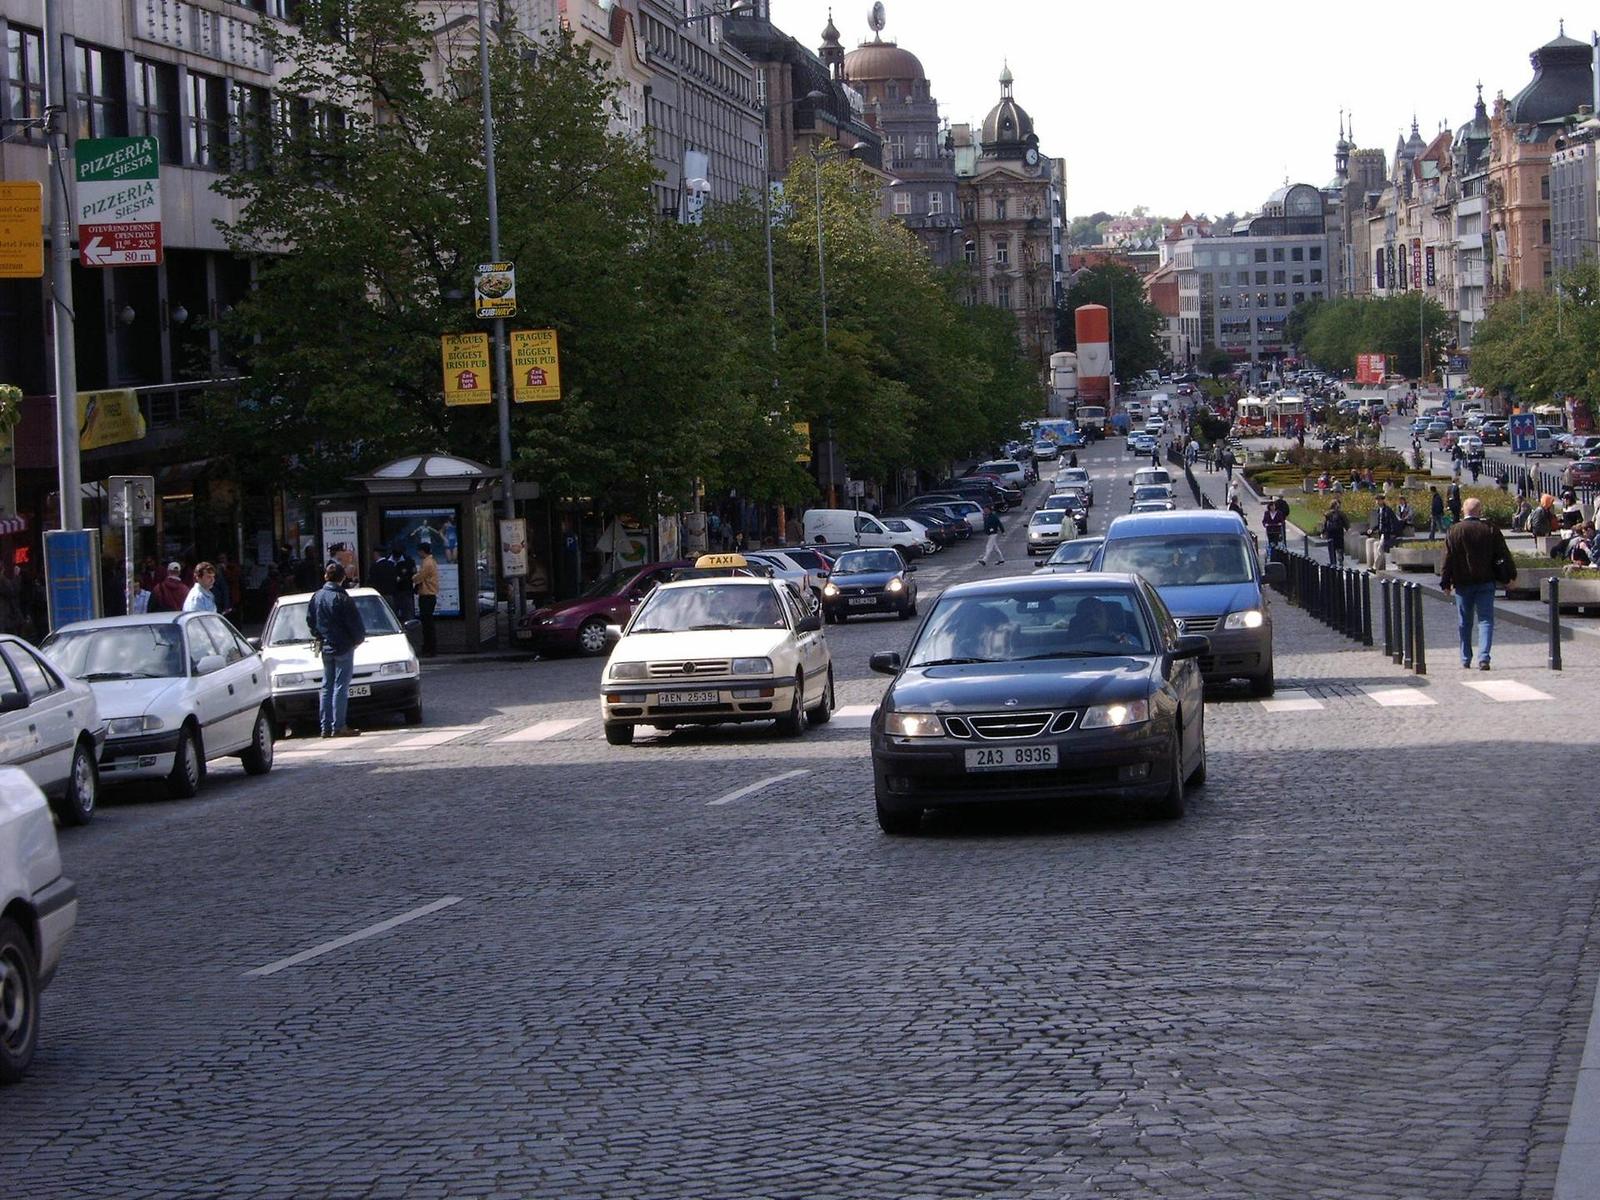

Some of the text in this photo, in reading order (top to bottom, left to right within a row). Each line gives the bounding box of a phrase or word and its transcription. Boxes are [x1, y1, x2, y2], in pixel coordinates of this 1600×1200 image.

[80, 139, 152, 178] PIZZERIA
[113, 154, 153, 178] SIESTA
[83, 181, 154, 219] PIZZERIA
[115, 196, 155, 219] SIESTA
[125, 252, 138, 261] 80
[478, 264, 512, 272] SUBWAY
[479, 308, 513, 317] SUBWAY
[446, 335, 484, 345] PRAGUES
[515, 332, 552, 341] PRAGUES
[448, 350, 483, 360] BIGGEST
[517, 347, 552, 357] BIGGEST
[446, 360, 487, 369] IRISH PUB
[515, 356, 556, 366] IRISH PUB
[709, 556, 734, 564] TAXI
[664, 692, 713, 703] AEN 25-39
[977, 747, 1051, 765] 2A3 8936
